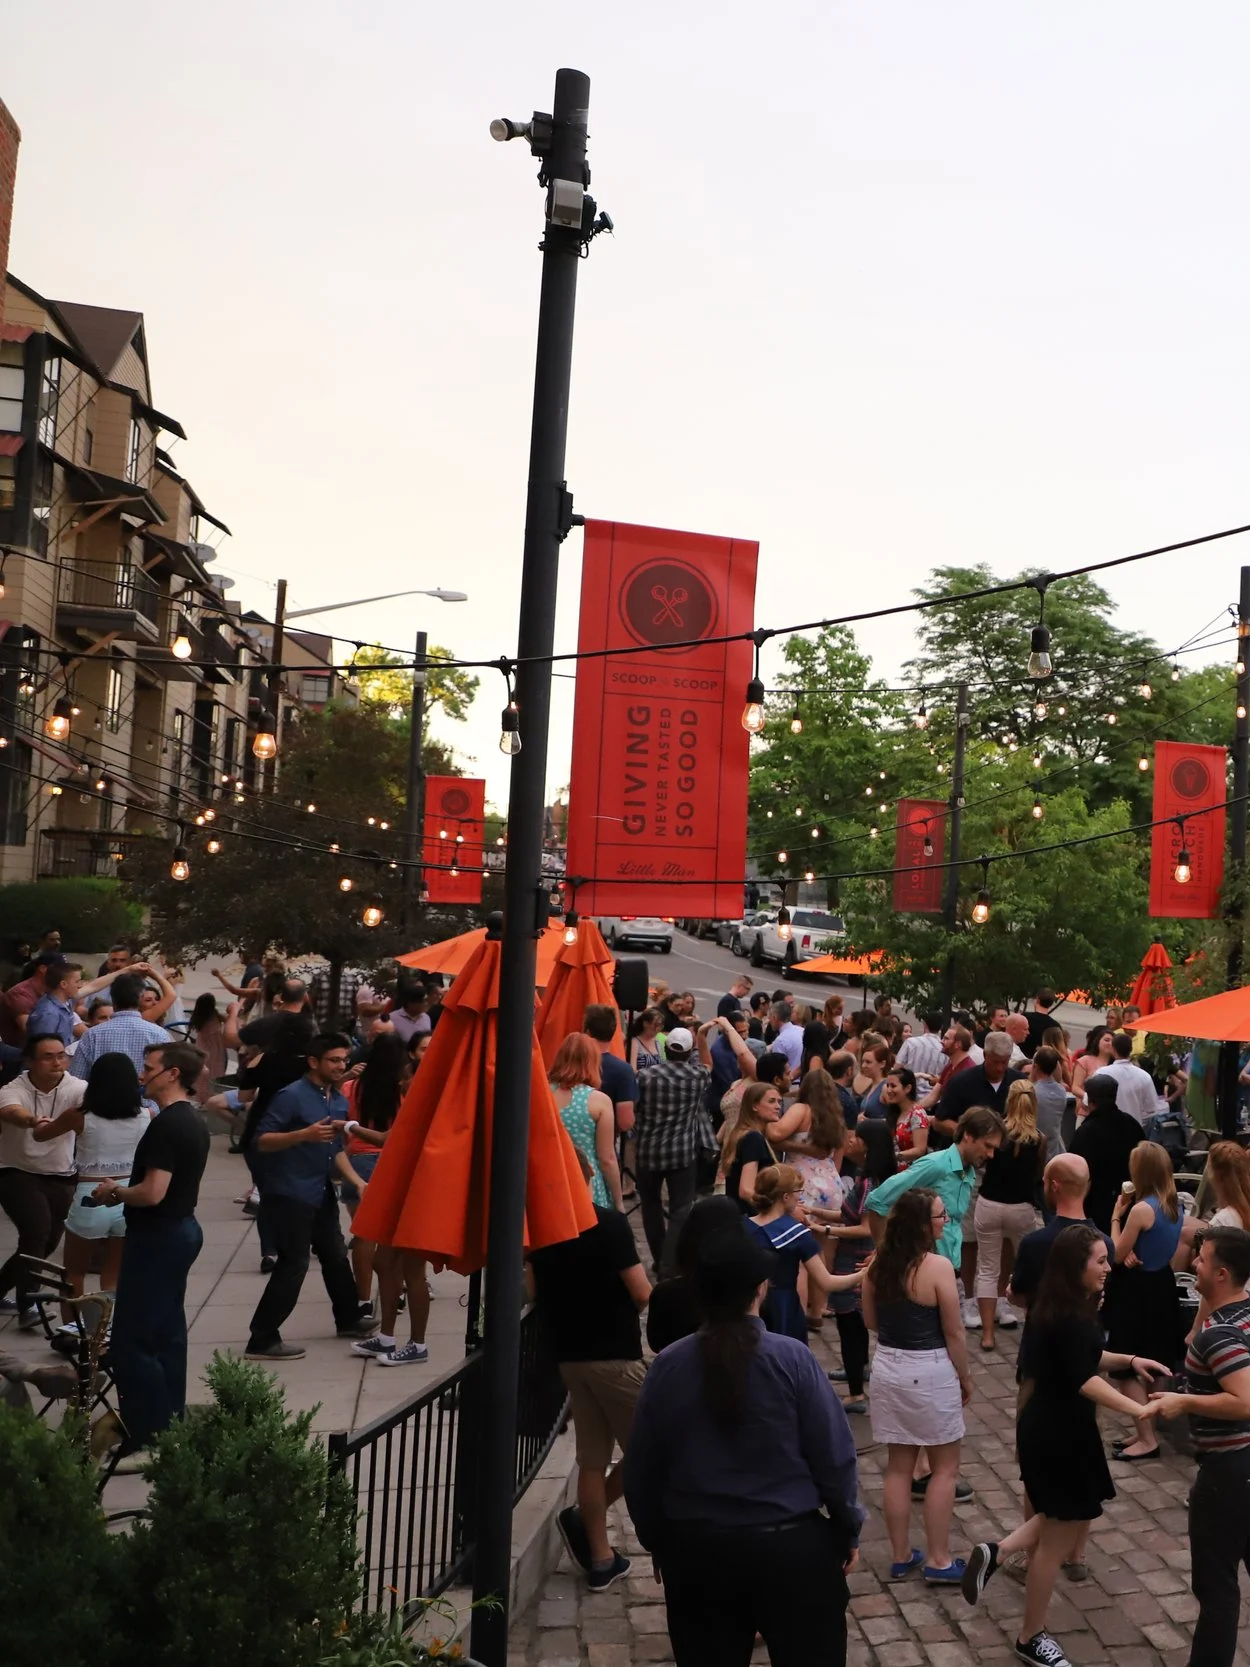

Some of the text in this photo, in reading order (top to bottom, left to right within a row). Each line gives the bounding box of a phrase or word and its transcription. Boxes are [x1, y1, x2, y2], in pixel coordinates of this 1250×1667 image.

[611, 672, 657, 686] SCOOP
[672, 677, 718, 691] SCOOP
[622, 705, 651, 836] GIVING
[654, 707, 672, 837] NEVER TASTED
[674, 709, 699, 838] SO GOOD
[616, 859, 696, 878] Little Man
[911, 851, 921, 890] LOAL
